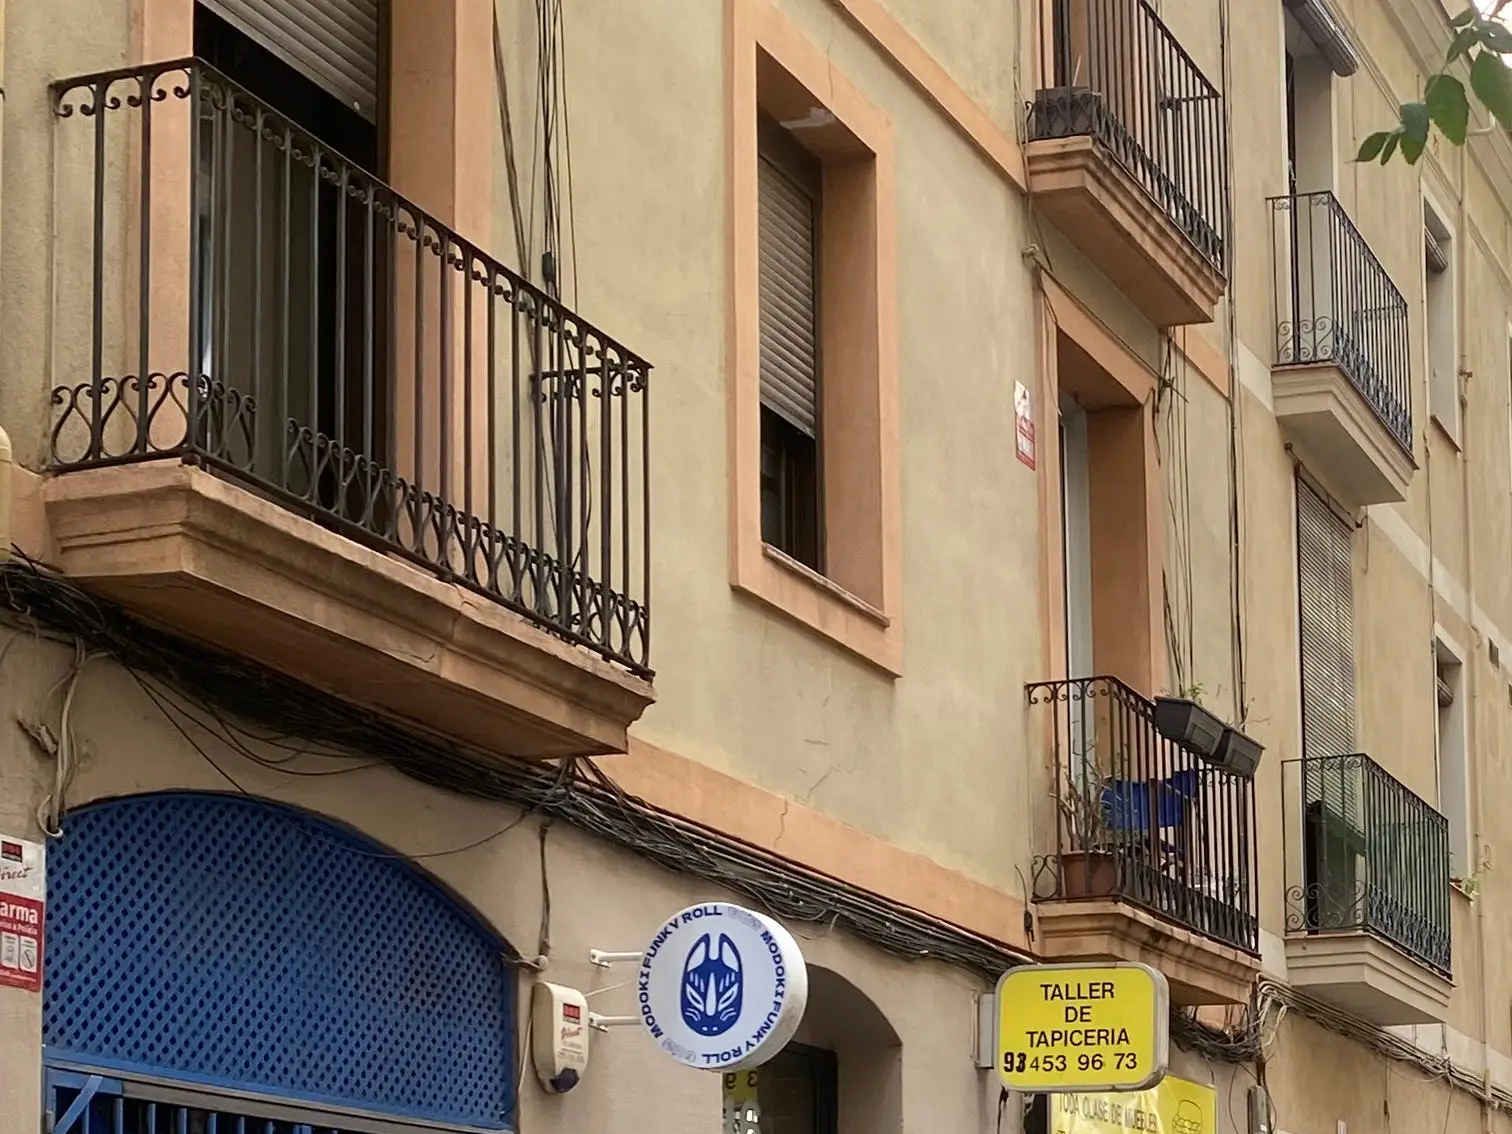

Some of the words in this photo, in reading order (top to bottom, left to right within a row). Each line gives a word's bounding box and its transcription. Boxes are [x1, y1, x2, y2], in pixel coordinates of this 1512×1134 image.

[682, 905, 723, 924] ROLL
[642, 918, 680, 969] FUNKY
[760, 930, 786, 999] MODOKI
[1040, 982, 1115, 1001] TALLER
[638, 972, 664, 1039] MODOKI
[1064, 1006, 1092, 1023] DE
[743, 1001, 782, 1054] FUNKY
[1025, 1028, 1130, 1048] TAPICERIA
[701, 1045, 742, 1064] ROLL
[1077, 1053, 1104, 1071] 96
[1114, 1052, 1138, 1070] 73
[1111, 1103, 1122, 1127] DE
